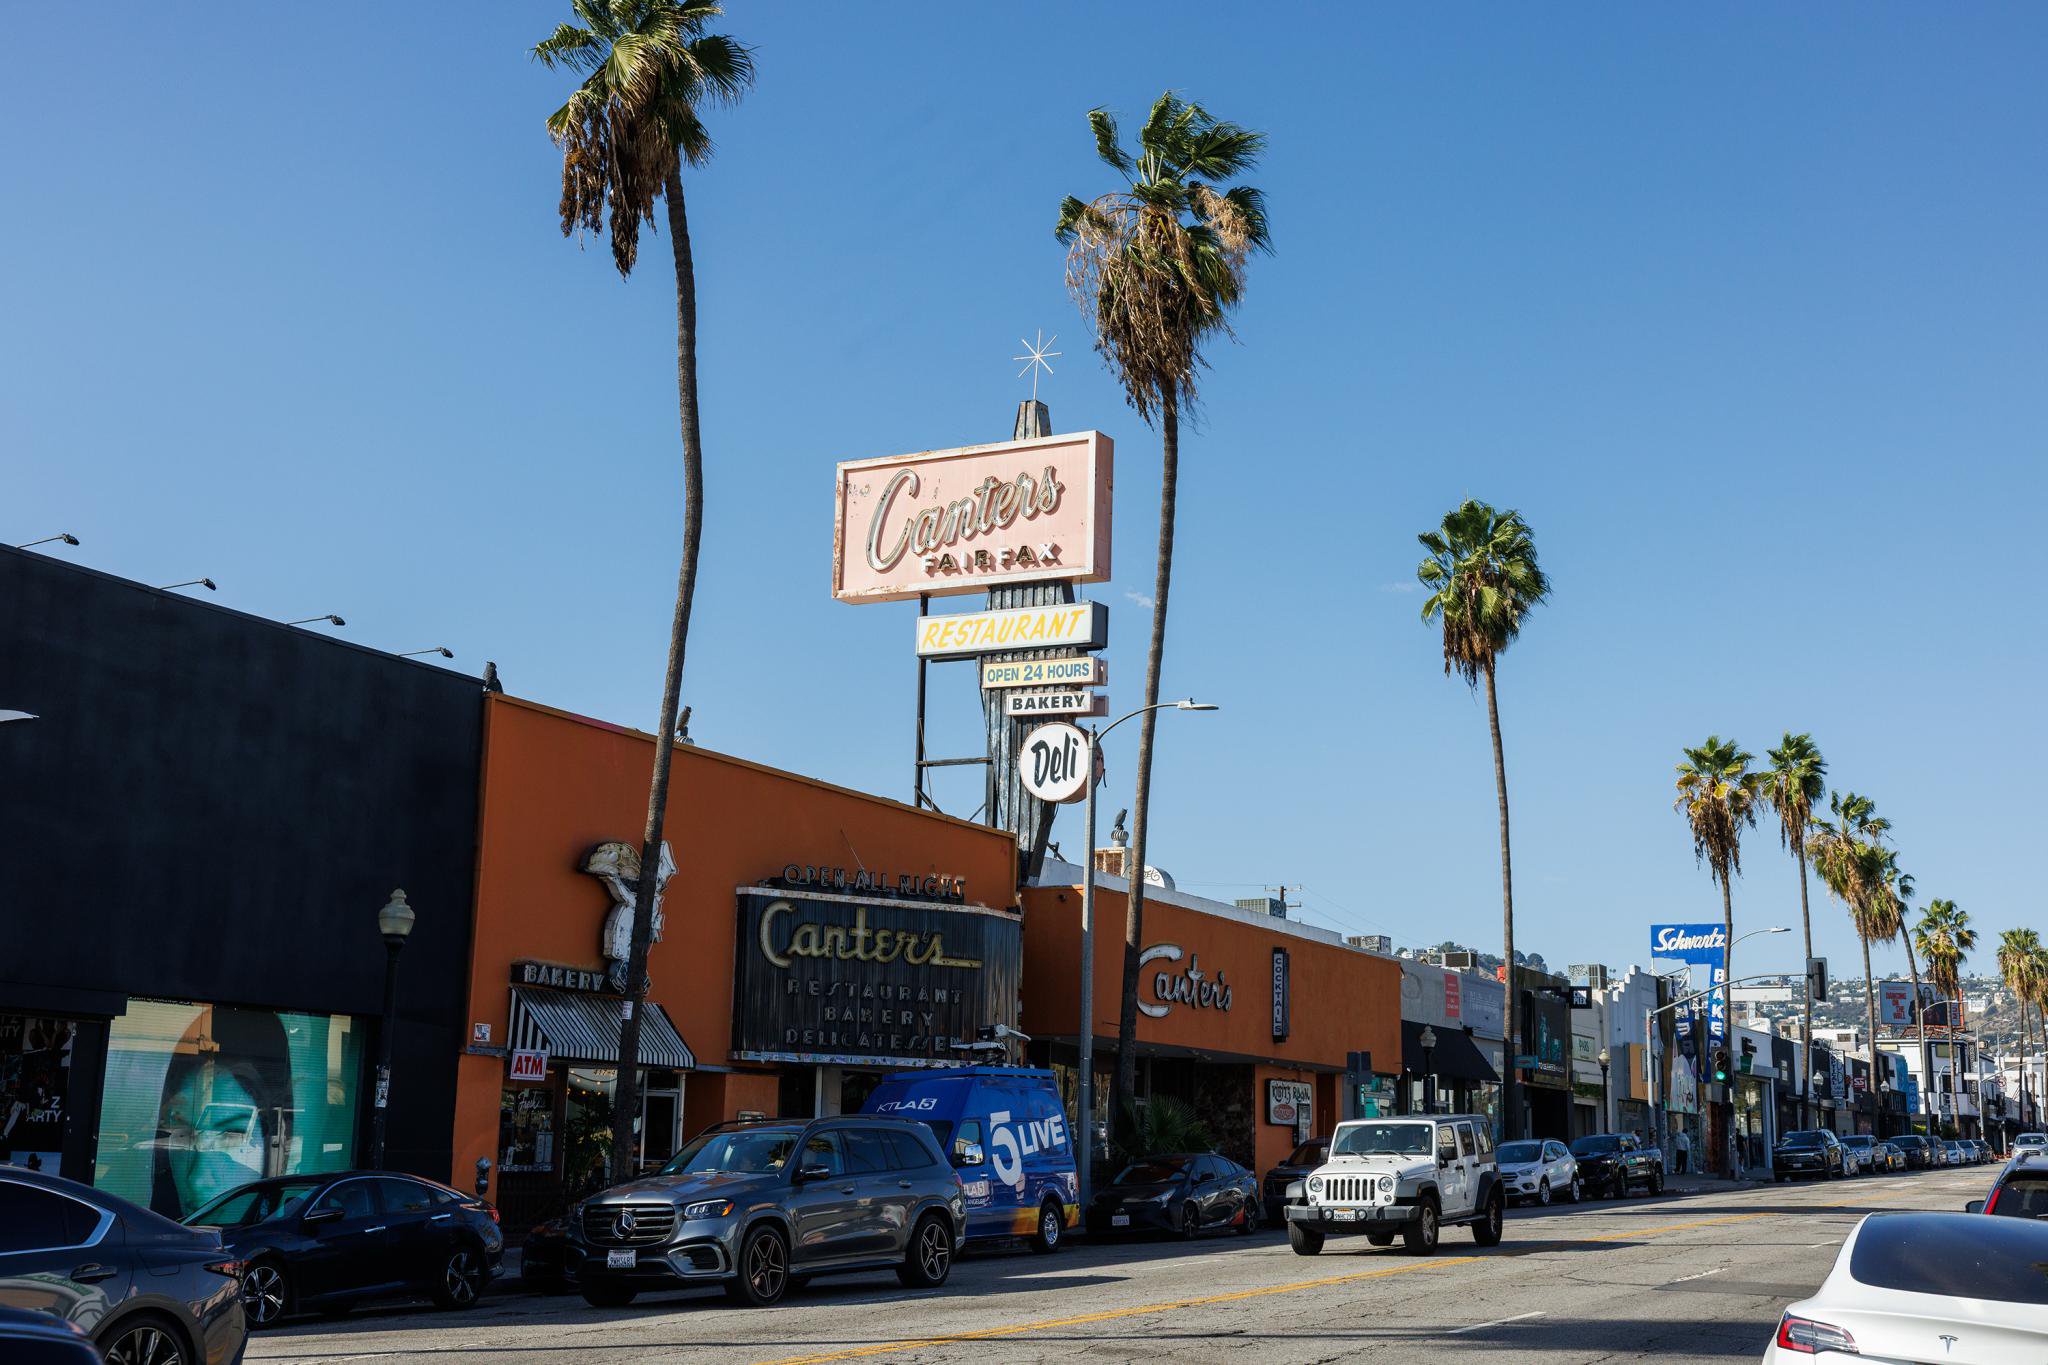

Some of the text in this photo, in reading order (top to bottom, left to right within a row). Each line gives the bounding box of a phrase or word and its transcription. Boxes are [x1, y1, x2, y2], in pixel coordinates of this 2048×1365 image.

[922, 541, 1061, 575] FAIRFAX
[922, 609, 1086, 649] RESTAURANT
[987, 662, 1090, 683] OPEN 24 HOURS
[1012, 694, 1086, 711] BAKERY
[1031, 732, 1079, 788] Deli
[784, 864, 965, 898] OPEN ALL NIGHT
[1653, 928, 1725, 952] Schwartz
[524, 965, 605, 992] BAKERY
[786, 977, 962, 1005] RESTAURANT
[1274, 956, 1283, 1034] COCKTAILS
[824, 1005, 935, 1027] BAKERY
[513, 1055, 543, 1075] ATM
[26, 1110, 63, 1123] ARTY
[990, 1110, 1067, 1187] 5 LIVE
